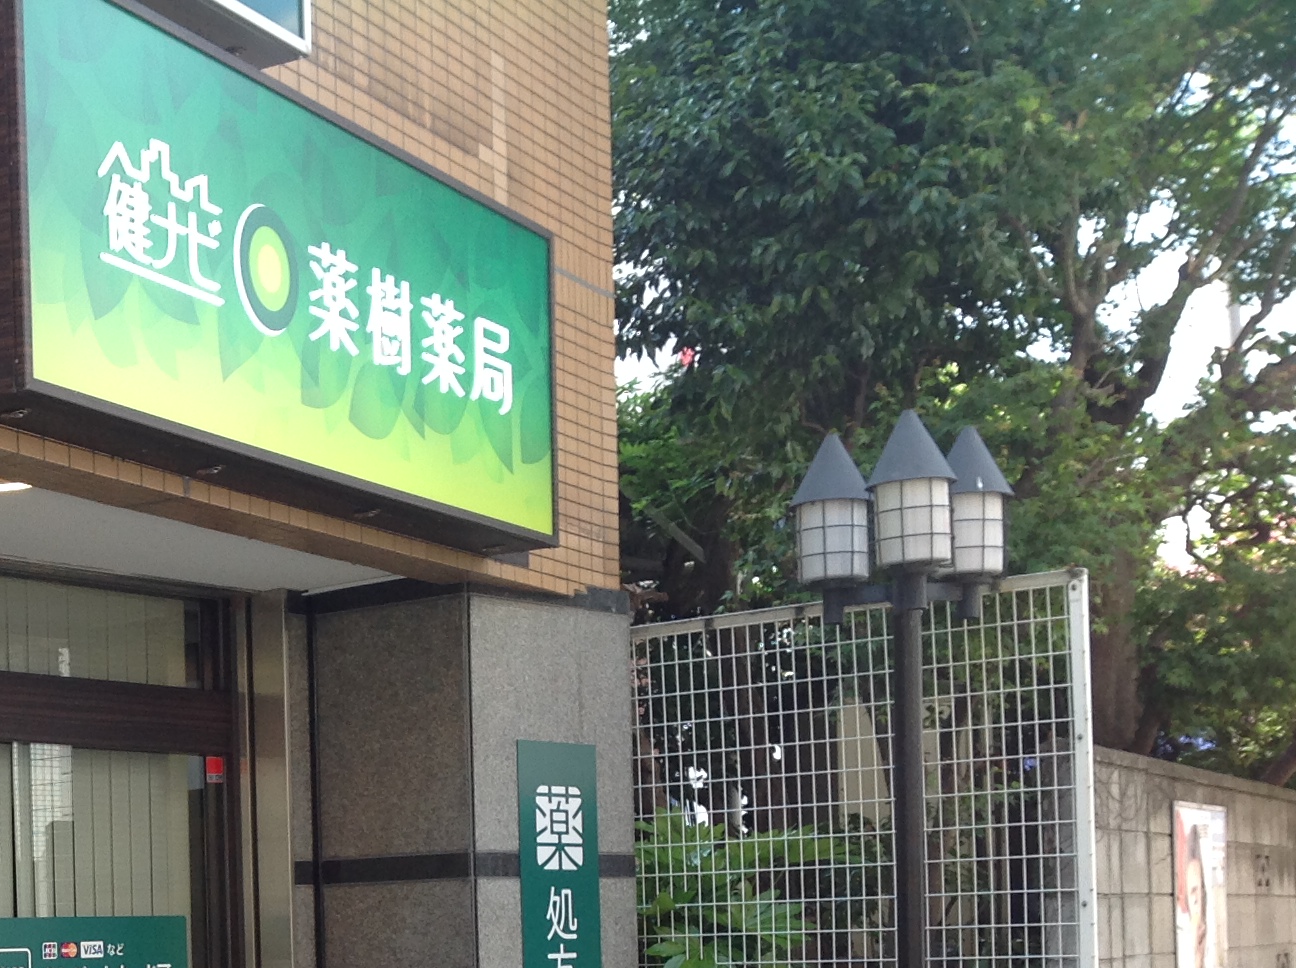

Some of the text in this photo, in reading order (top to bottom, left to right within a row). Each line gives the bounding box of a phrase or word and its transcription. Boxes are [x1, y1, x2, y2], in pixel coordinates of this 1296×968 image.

[308, 242, 513, 415] 薬樹薬局
[535, 784, 584, 871] 薬
[83, 944, 103, 956] VISA
[107, 943, 124, 956] など
